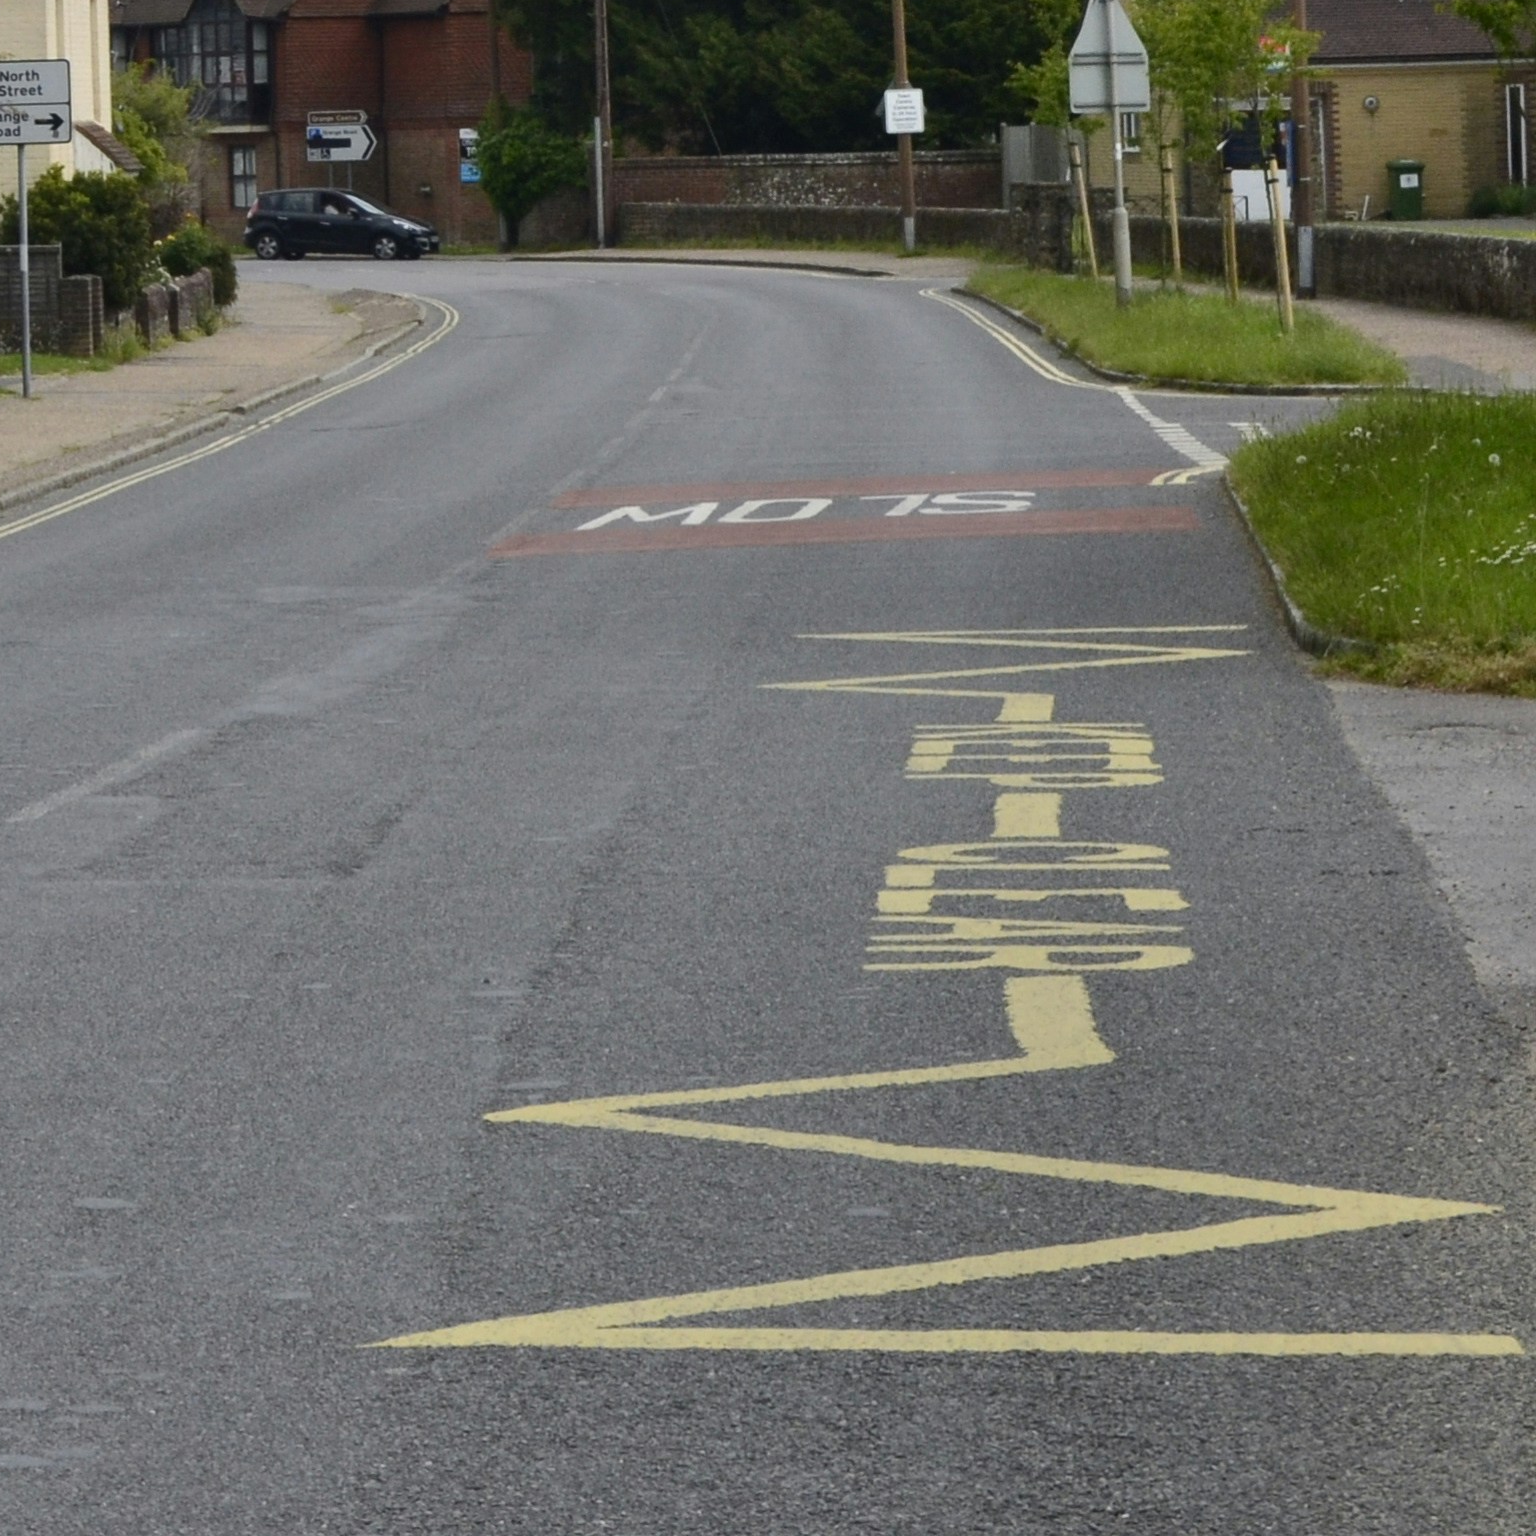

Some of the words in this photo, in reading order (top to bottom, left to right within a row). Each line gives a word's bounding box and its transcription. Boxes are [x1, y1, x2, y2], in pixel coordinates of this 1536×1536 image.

[0, 70, 40, 82] North
[575, 491, 1036, 530] SLOW
[903, 723, 1166, 788] KEEP
[862, 841, 1195, 970] CLEAR
